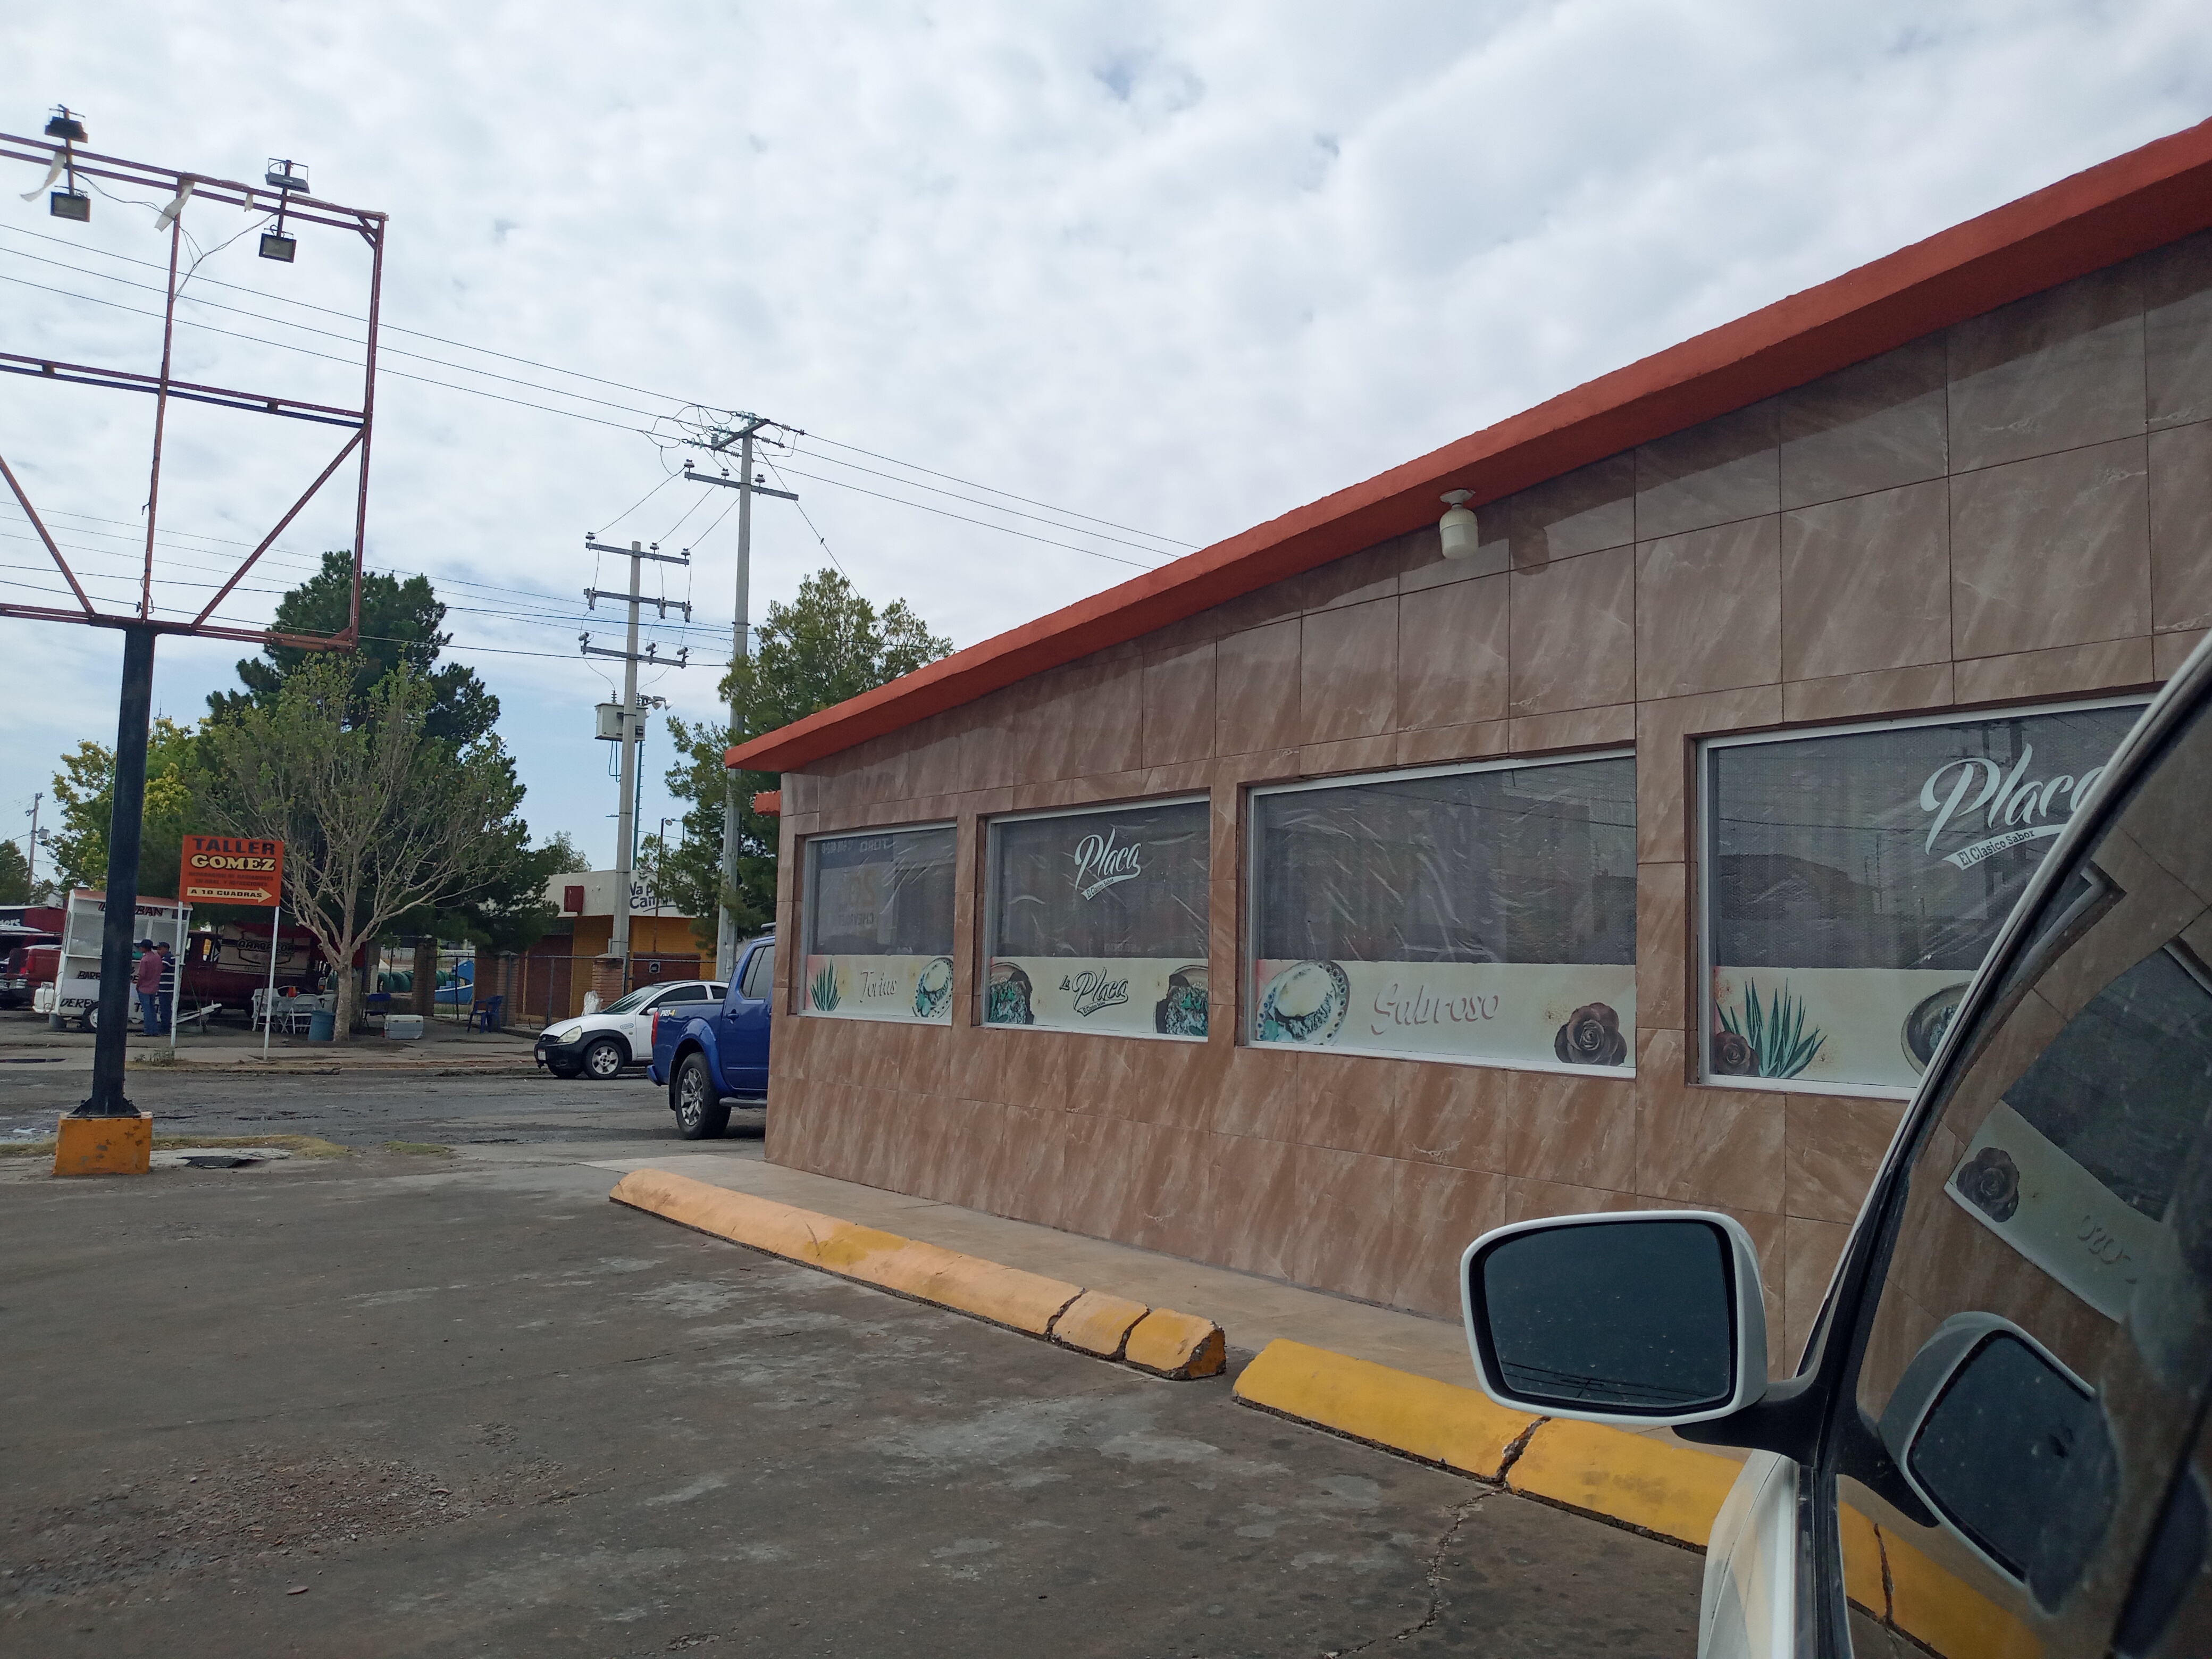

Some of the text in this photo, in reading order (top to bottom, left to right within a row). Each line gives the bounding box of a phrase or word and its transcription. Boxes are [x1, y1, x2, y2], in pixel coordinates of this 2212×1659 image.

[190, 853, 276, 872] GOMEZ
[192, 837, 275, 856] TALLER
[1074, 827, 1142, 891] Placa
[1957, 830, 2035, 866] El Clasico Sabor
[1059, 967, 1128, 1011] La Placa
